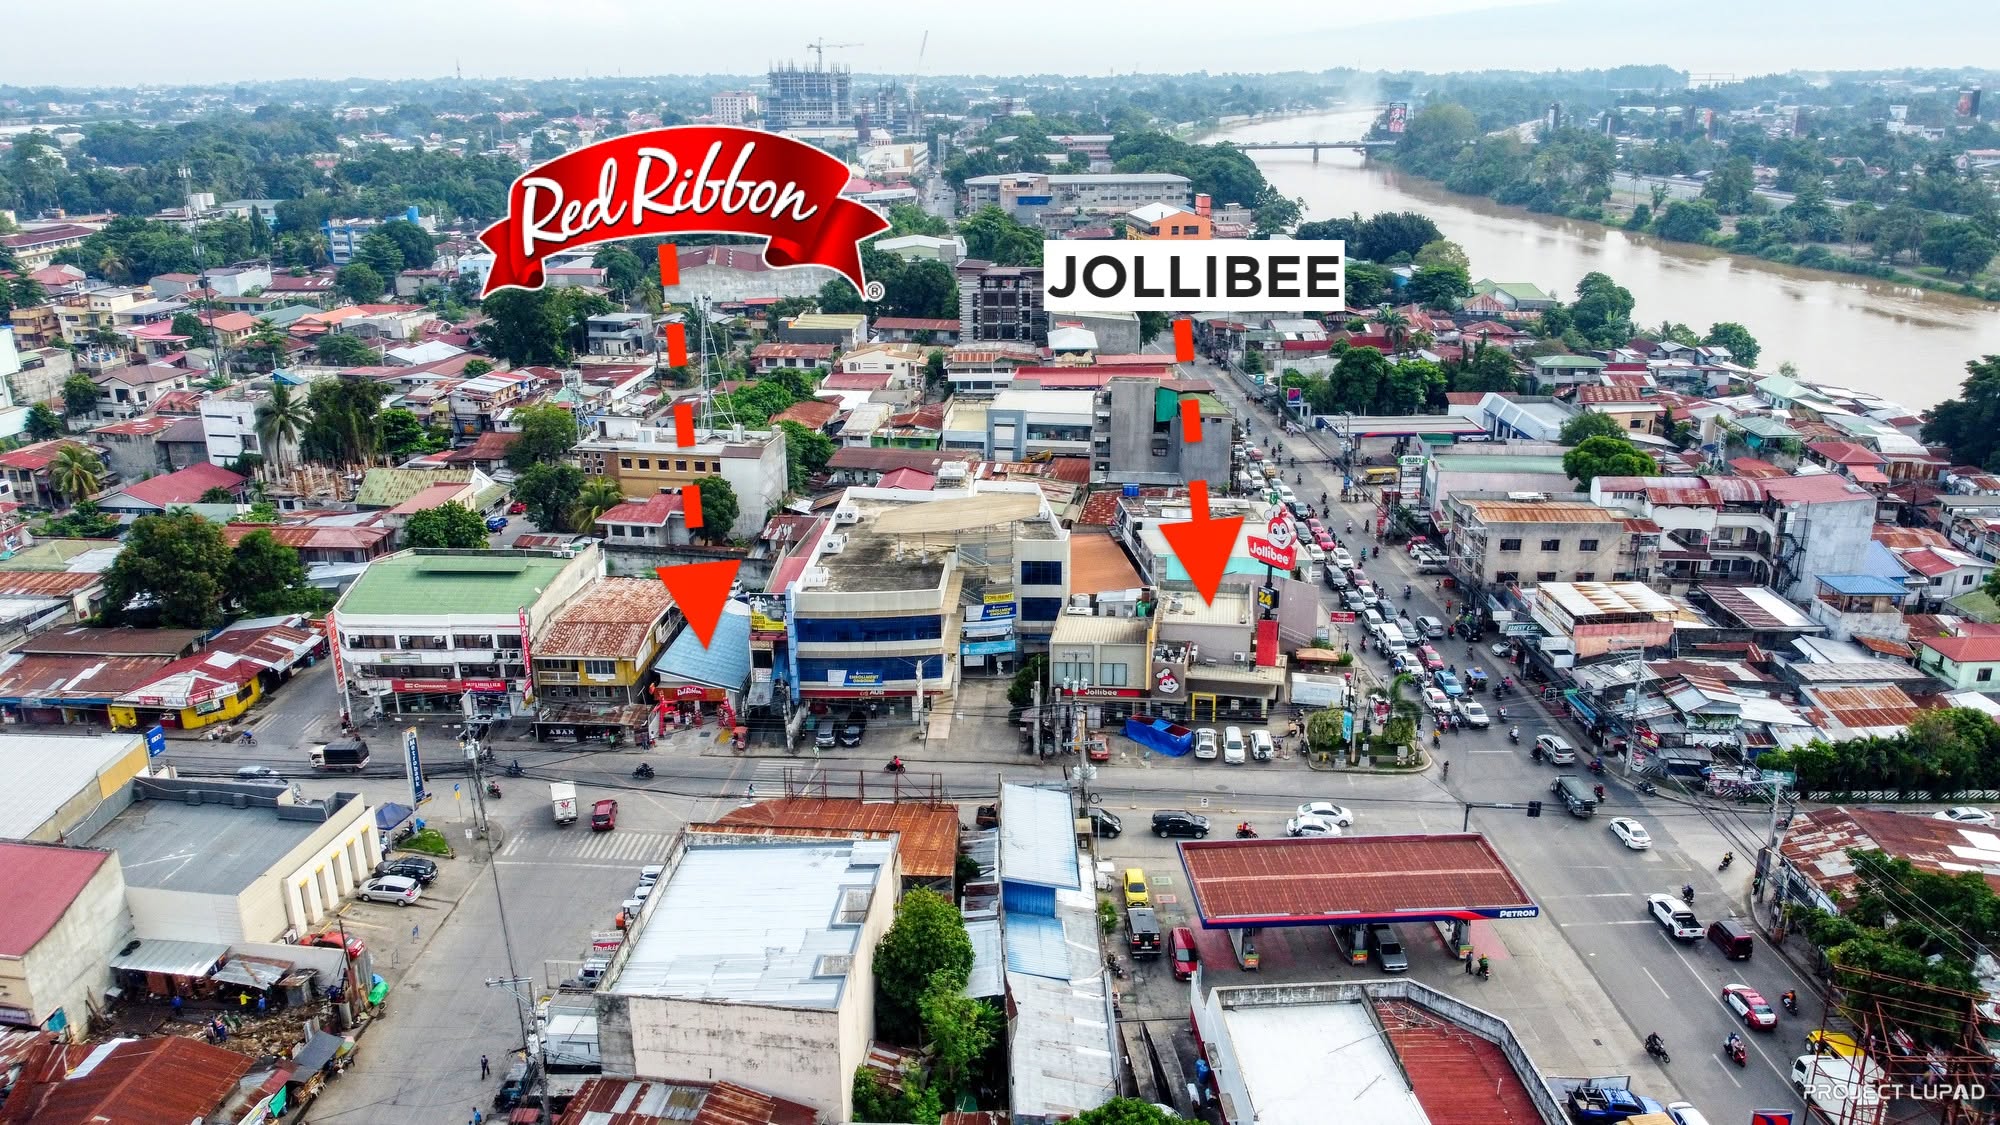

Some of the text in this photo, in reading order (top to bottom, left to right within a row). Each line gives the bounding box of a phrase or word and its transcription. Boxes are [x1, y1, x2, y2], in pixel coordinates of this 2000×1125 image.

[1250, 541, 1290, 565] Jollibee
[1258, 591, 1272, 606] 24
[1084, 688, 1117, 696] Jollibee
[1499, 909, 1536, 918] PETRON
